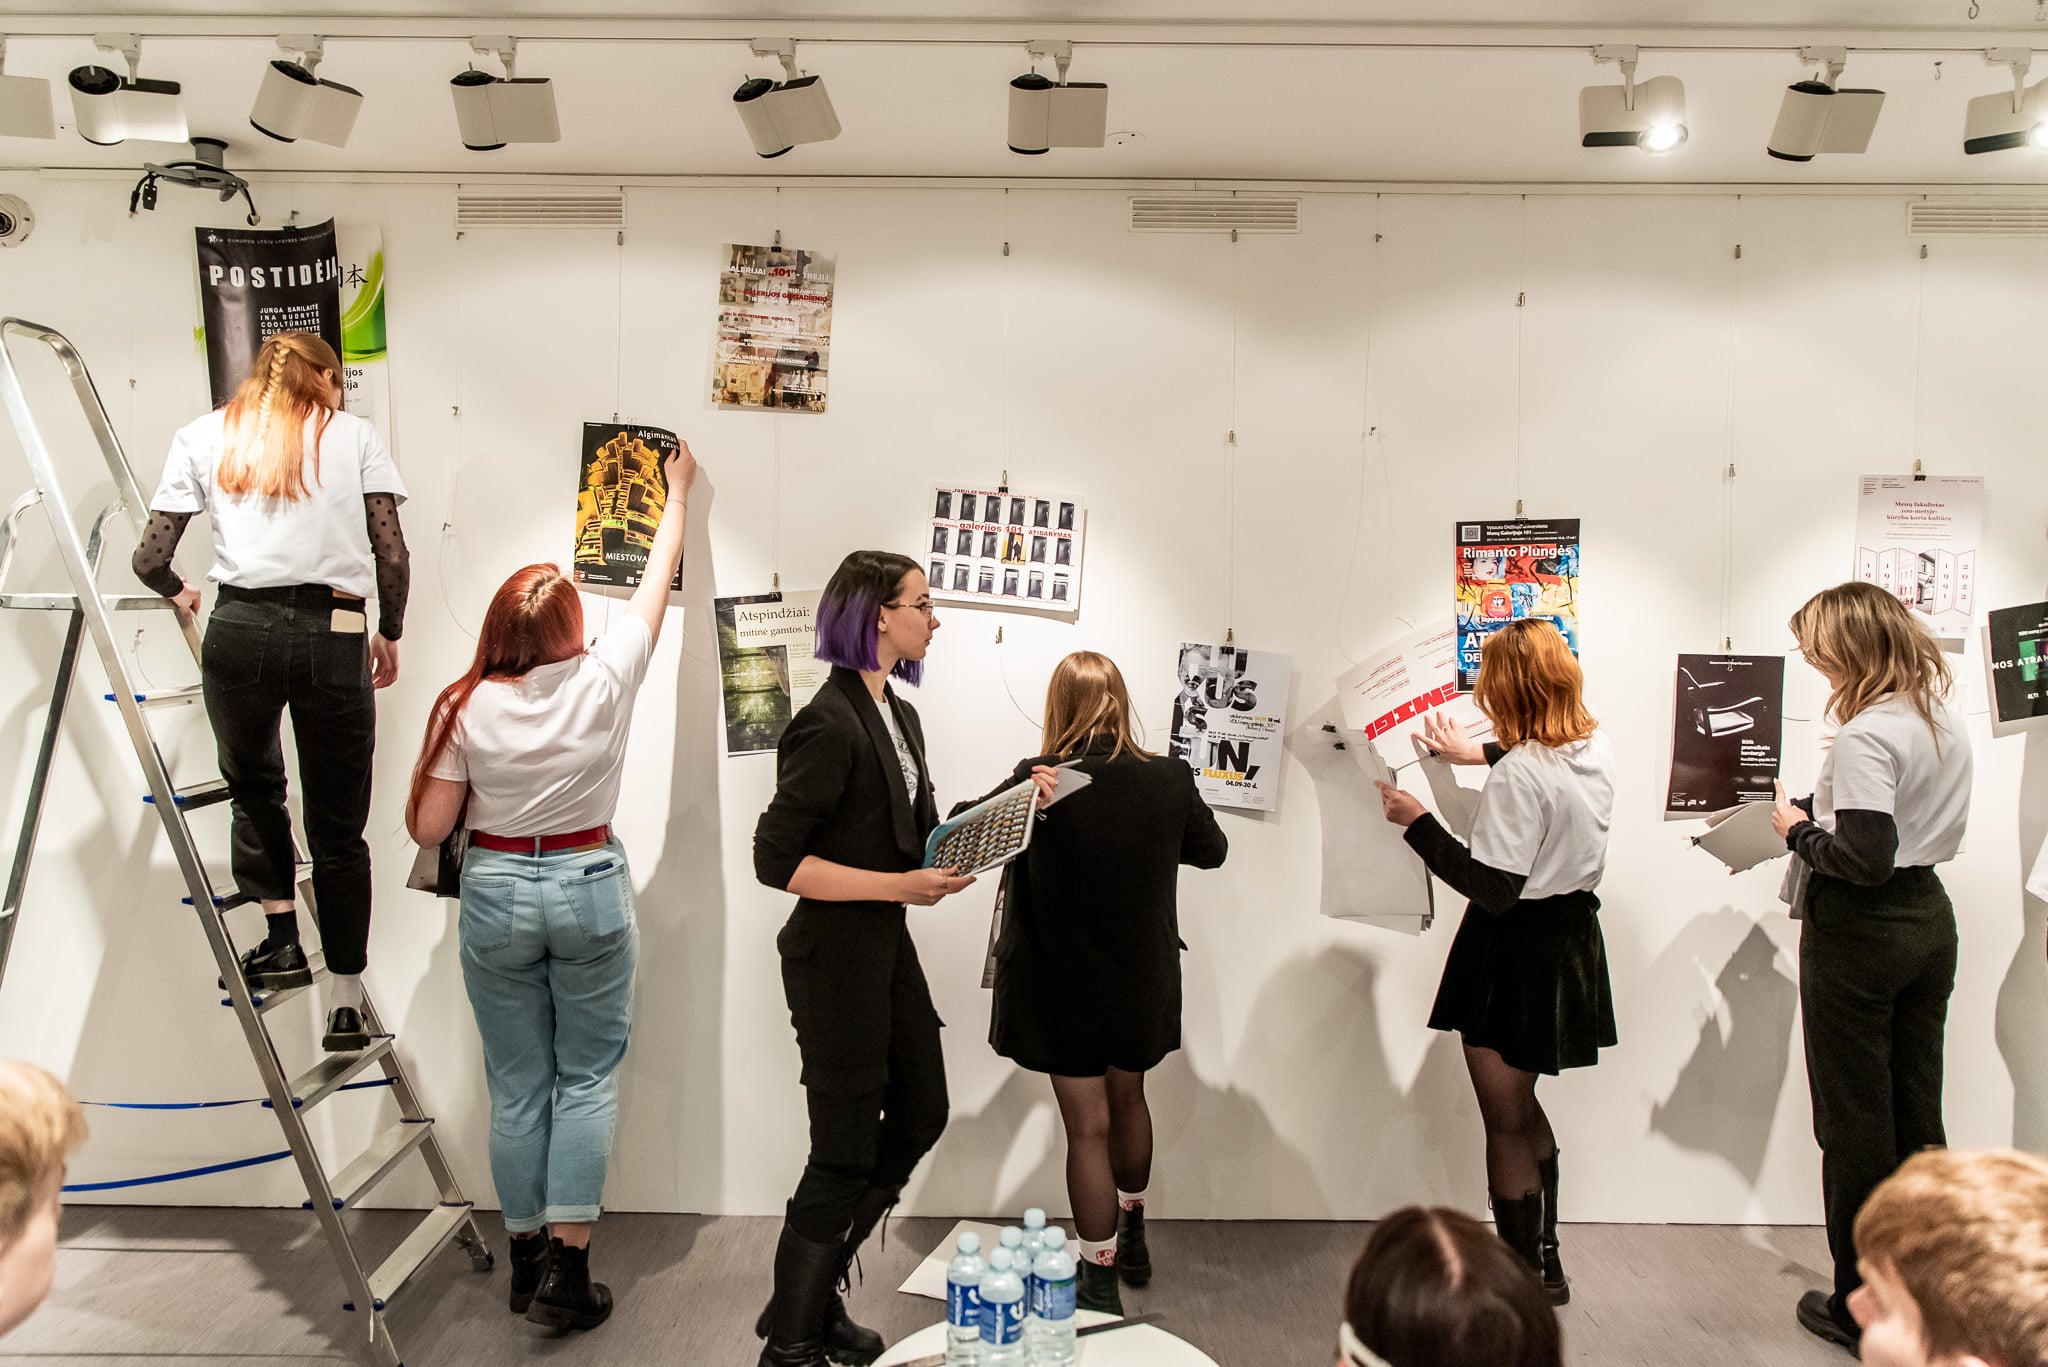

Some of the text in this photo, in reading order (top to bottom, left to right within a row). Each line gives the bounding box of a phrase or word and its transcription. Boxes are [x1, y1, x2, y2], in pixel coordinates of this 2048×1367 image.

[282, 310, 319, 320] BUDRYTĖ
[959, 522, 1002, 533] galerijos
[1005, 525, 1022, 534] 101
[1028, 529, 1072, 539] ATIDARYMAS
[1463, 544, 1572, 559] Rimanto Plungės
[739, 606, 810, 623] Atspindžiai:
[740, 629, 768, 638] mitinė
[770, 627, 802, 638] gamtos
[1203, 768, 1243, 781] FLUXUS
